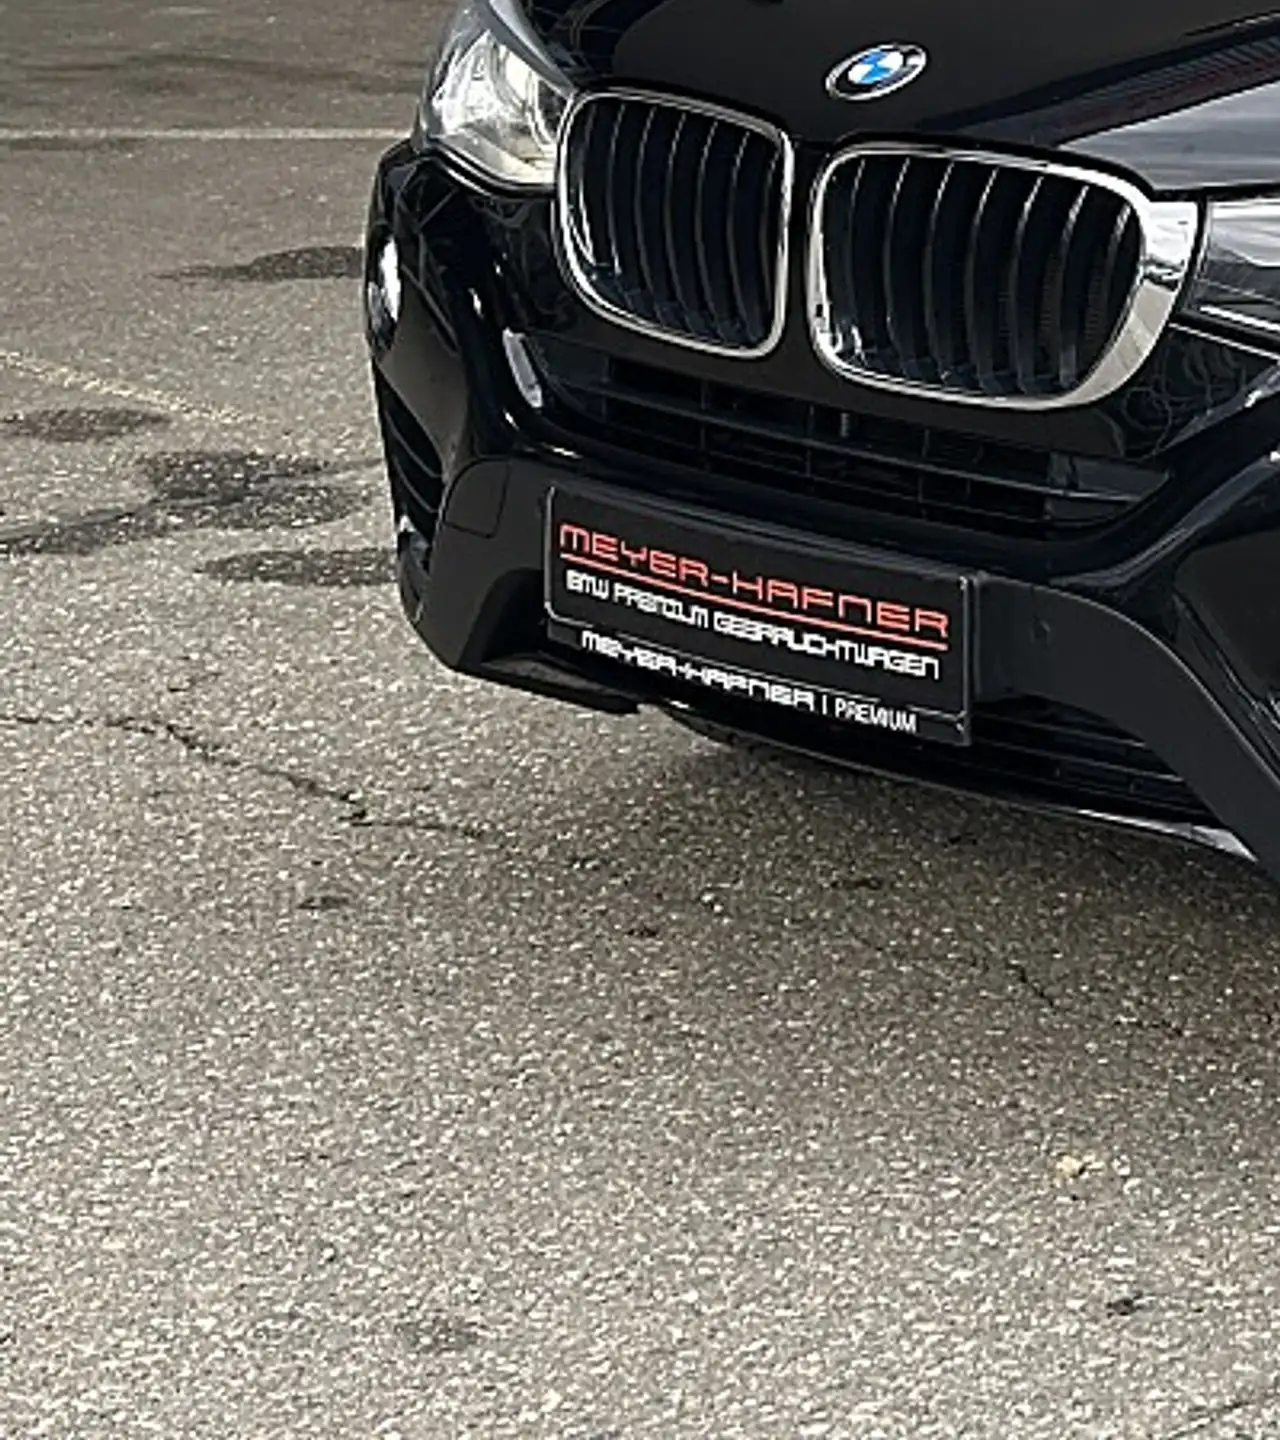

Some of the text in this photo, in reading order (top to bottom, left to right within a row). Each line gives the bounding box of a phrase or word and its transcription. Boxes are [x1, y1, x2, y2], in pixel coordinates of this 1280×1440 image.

[559, 522, 949, 637] MEYER-HAFNER
[565, 568, 611, 600] BMW
[612, 586, 710, 630] PREMIUM
[834, 699, 917, 735] PREMIUM
